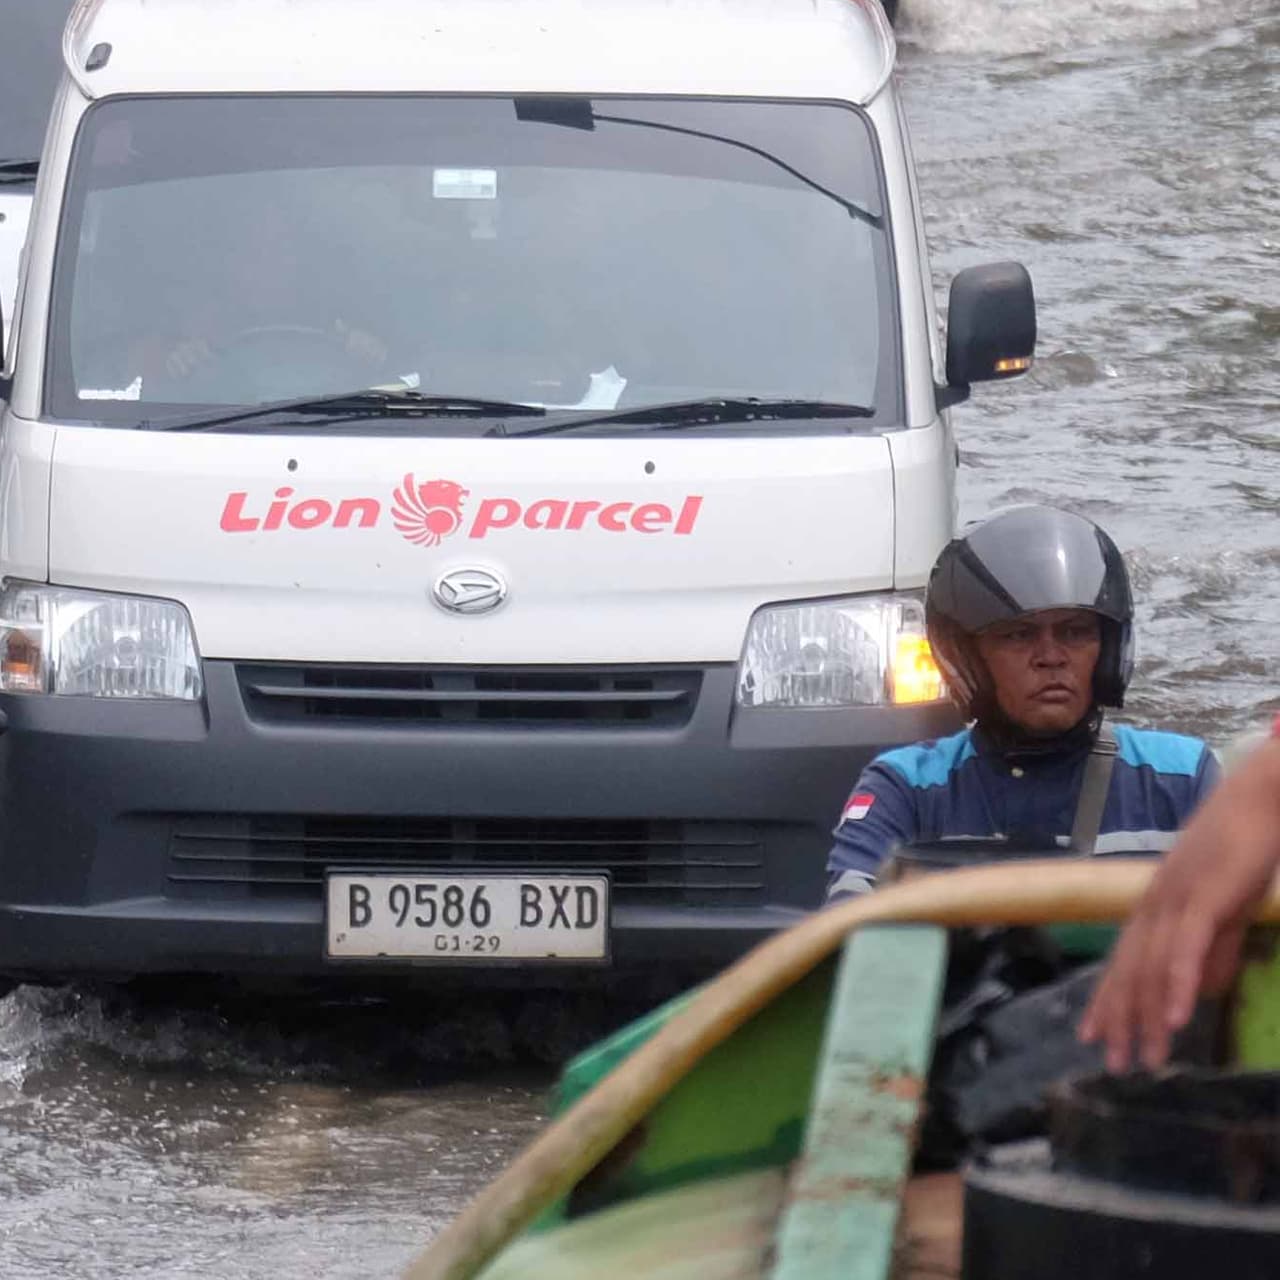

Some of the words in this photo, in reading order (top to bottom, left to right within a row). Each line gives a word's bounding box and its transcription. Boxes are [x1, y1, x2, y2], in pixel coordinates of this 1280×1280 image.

[219, 486, 381, 533] Lion
[469, 495, 704, 539] parcel
[348, 884, 372, 928] B
[388, 884, 491, 928] 9586
[520, 884, 599, 930] BXD
